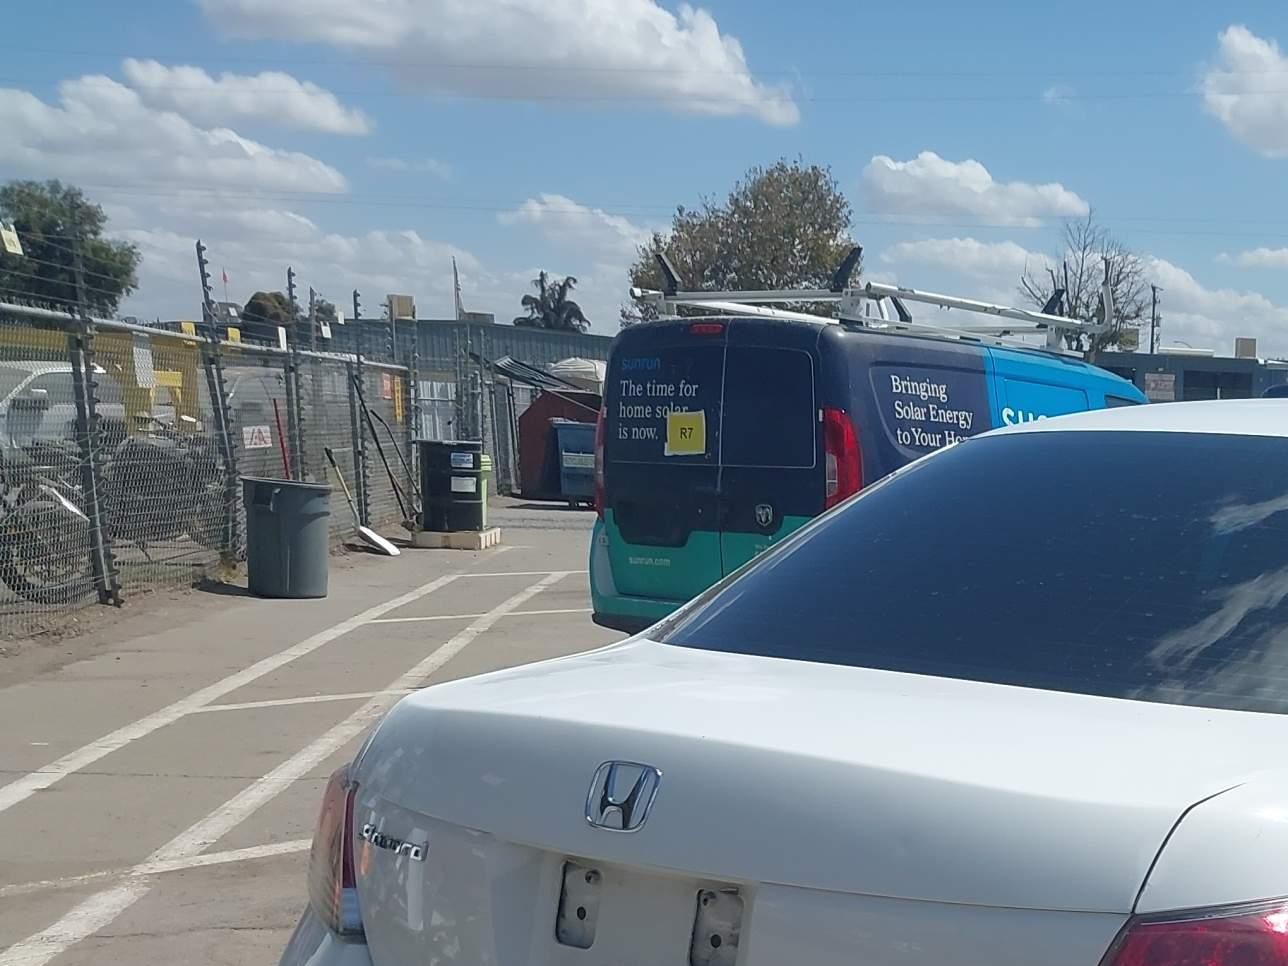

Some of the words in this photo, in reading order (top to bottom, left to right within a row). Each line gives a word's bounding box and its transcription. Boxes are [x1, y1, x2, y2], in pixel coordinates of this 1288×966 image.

[620, 380, 643, 397] The
[646, 380, 675, 397] time
[679, 380, 699, 397] for
[890, 374, 948, 403] Bringing
[619, 401, 652, 418] home
[894, 400, 927, 421] Solar
[928, 404, 974, 429] Energy
[618, 423, 628, 439] is
[631, 427, 659, 440] now.
[680, 427, 694, 440] R7
[896, 428, 911, 445] to
[910, 427, 942, 447] Your
